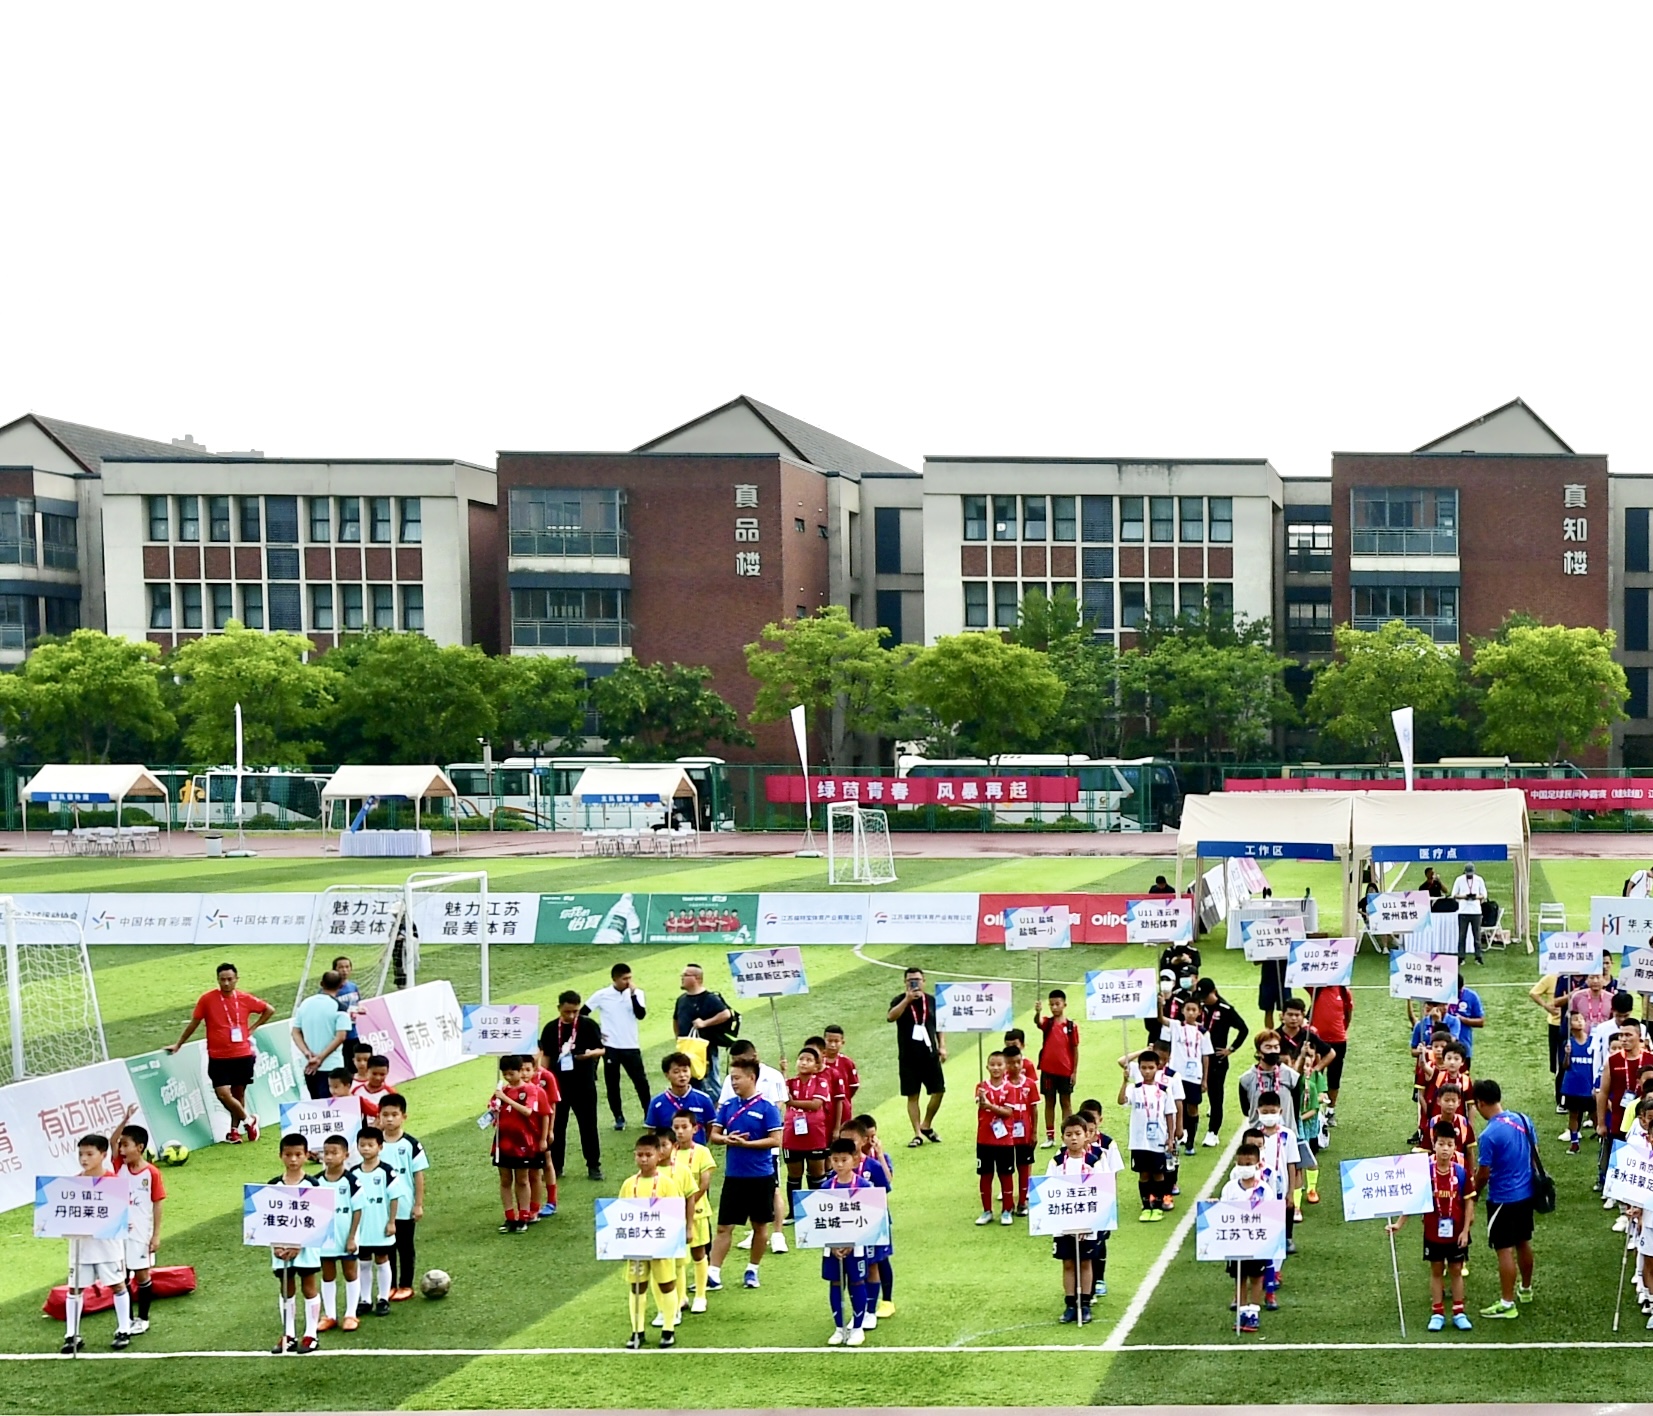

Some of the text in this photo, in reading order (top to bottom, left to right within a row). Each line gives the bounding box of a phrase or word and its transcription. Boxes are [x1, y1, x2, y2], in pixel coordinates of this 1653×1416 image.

[735, 483, 761, 577] 真品楼
[1563, 483, 1588, 576] 真知楼
[817, 781, 1028, 799] 绿茵青春 风暴再起
[1245, 846, 1283, 856] 工作区
[1419, 848, 1457, 859] 医疗点
[332, 901, 389, 916] 魅力江
[444, 901, 520, 917] 魅力江苏
[1401, 900, 1415, 909] 常州
[233, 915, 306, 926] 中国体育彩票
[1382, 910, 1418, 921] 常州喜悦
[120, 916, 193, 927] 中国体育彩票
[1141, 920, 1177, 928] 劲拓体育
[442, 920, 518, 936] 最美体育
[1019, 927, 1056, 936] 盐城一小
[1274, 927, 1289, 935] 徐州
[1257, 936, 1292, 948] 江苏飞克
[1323, 949, 1338, 958] 常州
[1548, 951, 1594, 962] 高邮外国语
[747, 961, 764, 969] U10
[1301, 961, 1339, 972] 常州为华
[1406, 963, 1441, 974] U10 常州
[736, 970, 801, 983] 高邮高新区实验
[1404, 974, 1443, 988] 常州喜悦
[1098, 980, 1143, 990] U10 连云港
[954, 993, 993, 1002] U10 盐城
[1101, 993, 1140, 1004] 劲拓体育
[952, 1006, 996, 1017] 盐城一小
[481, 1016, 521, 1025] U10 淮安
[404, 1020, 434, 1051] 南京
[478, 1029, 522, 1039] 淮安米兰
[38, 1090, 125, 1141] 有迈体育
[299, 1109, 341, 1121] U10 镇江
[298, 1122, 344, 1136] 丹阳莱恩
[1626, 1158, 1653, 1174] U9 南京
[1366, 1168, 1406, 1181] U9 常州
[1048, 1187, 1097, 1198] U9 连云港
[1362, 1182, 1413, 1198] 常州喜悦
[62, 1191, 103, 1201] U9 镇江
[269, 1200, 310, 1211] U9 淮安
[819, 1202, 861, 1212] U9 盐城
[1048, 1202, 1097, 1215] 劲拓体育
[54, 1206, 109, 1219] 丹阳莱恩
[621, 1211, 660, 1222] U9 扬州
[262, 1214, 315, 1228] 淮安小象
[814, 1217, 868, 1229] 盐城一小
[1221, 1213, 1261, 1224] U9 徐州
[615, 1226, 666, 1239] 高邮大金
[1216, 1228, 1267, 1241] 江苏飞克
[857, 1260, 865, 1277] 9
